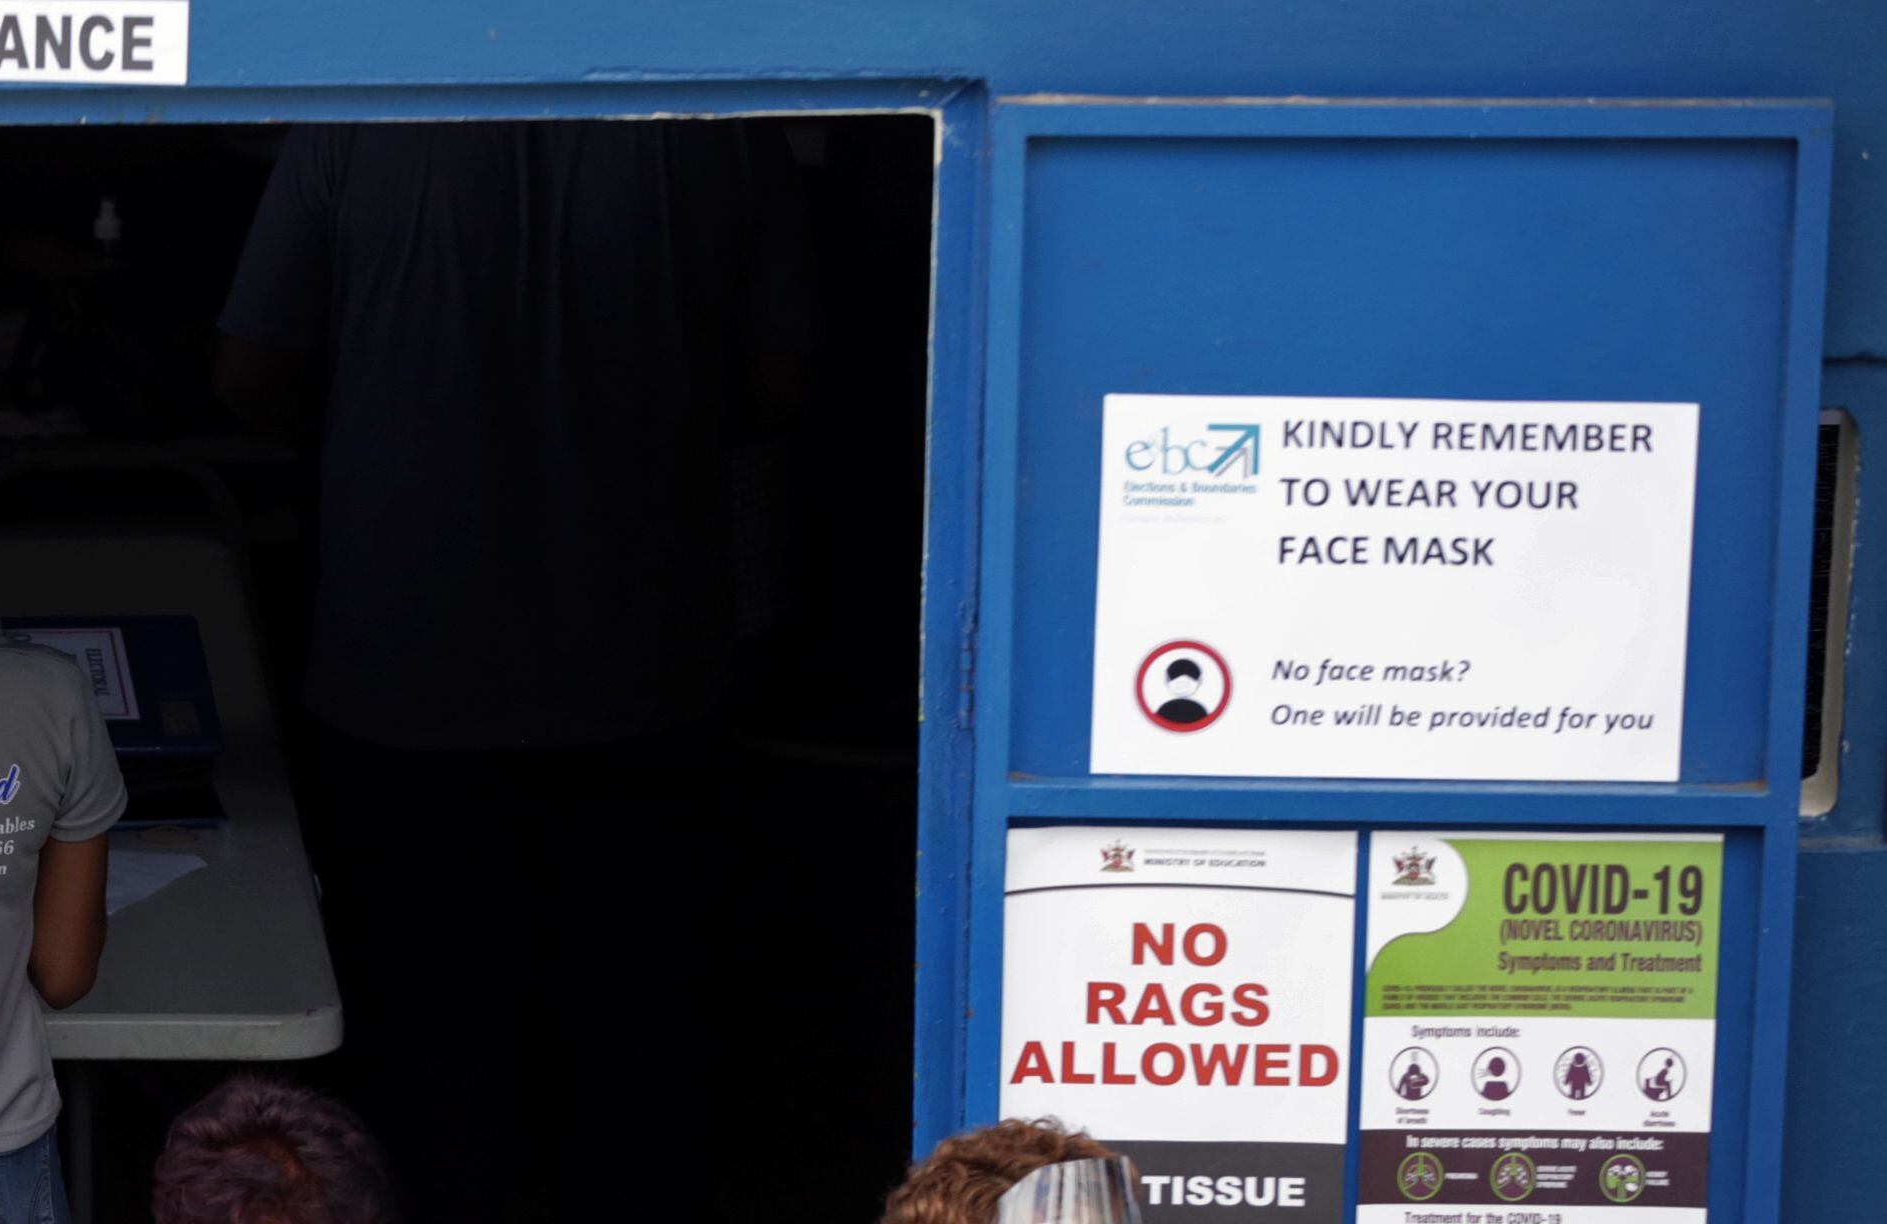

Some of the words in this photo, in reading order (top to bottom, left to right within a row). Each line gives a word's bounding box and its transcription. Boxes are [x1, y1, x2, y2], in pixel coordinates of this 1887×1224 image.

[1282, 421, 1419, 450] KINDLY
[1432, 423, 1653, 452] REMEMBER
[1280, 478, 1330, 507] TO
[1344, 480, 1458, 508] WEAR
[1471, 481, 1579, 510] YOUR
[1279, 537, 1369, 565] FACE
[1383, 538, 1494, 566] MASK
[85, 648, 110, 696] ELECTORAL
[1272, 661, 1309, 682] No
[1315, 660, 1374, 685] face
[1382, 661, 1471, 683] mask?
[1271, 705, 1324, 727] One
[1333, 705, 1380, 727] will
[1392, 706, 1420, 728] be
[1429, 706, 1548, 732] provided
[1554, 707, 1596, 734] for
[1604, 713, 1654, 733] you
[1503, 862, 1704, 915] COVID-19
[1132, 923, 1228, 967] NO
[1499, 919, 1563, 944] (NOVEL
[1569, 920, 1702, 946] CORONAVIRUS)
[1498, 952, 1581, 974] Symptoms
[1586, 954, 1615, 970] and
[1621, 953, 1701, 972] Treatment
[1085, 981, 1270, 1027] RAGS
[1411, 1025, 1472, 1039] Symptoms
[1476, 1025, 1520, 1038] include:
[1009, 1041, 1340, 1087] ALLOWED
[1406, 1135, 1419, 1148] In
[1421, 1137, 1460, 1148] severe
[1461, 1137, 1496, 1148] cases
[1498, 1136, 1559, 1151] symptoms
[1561, 1138, 1587, 1152] may
[1589, 1136, 1614, 1149] also
[1616, 1136, 1664, 1150] include:
[1141, 1176, 1305, 1207] TISSUE
[1404, 1211, 1462, 1224] Treatment
[1466, 1212, 1482, 1224] for
[1486, 1213, 1503, 1224] the
